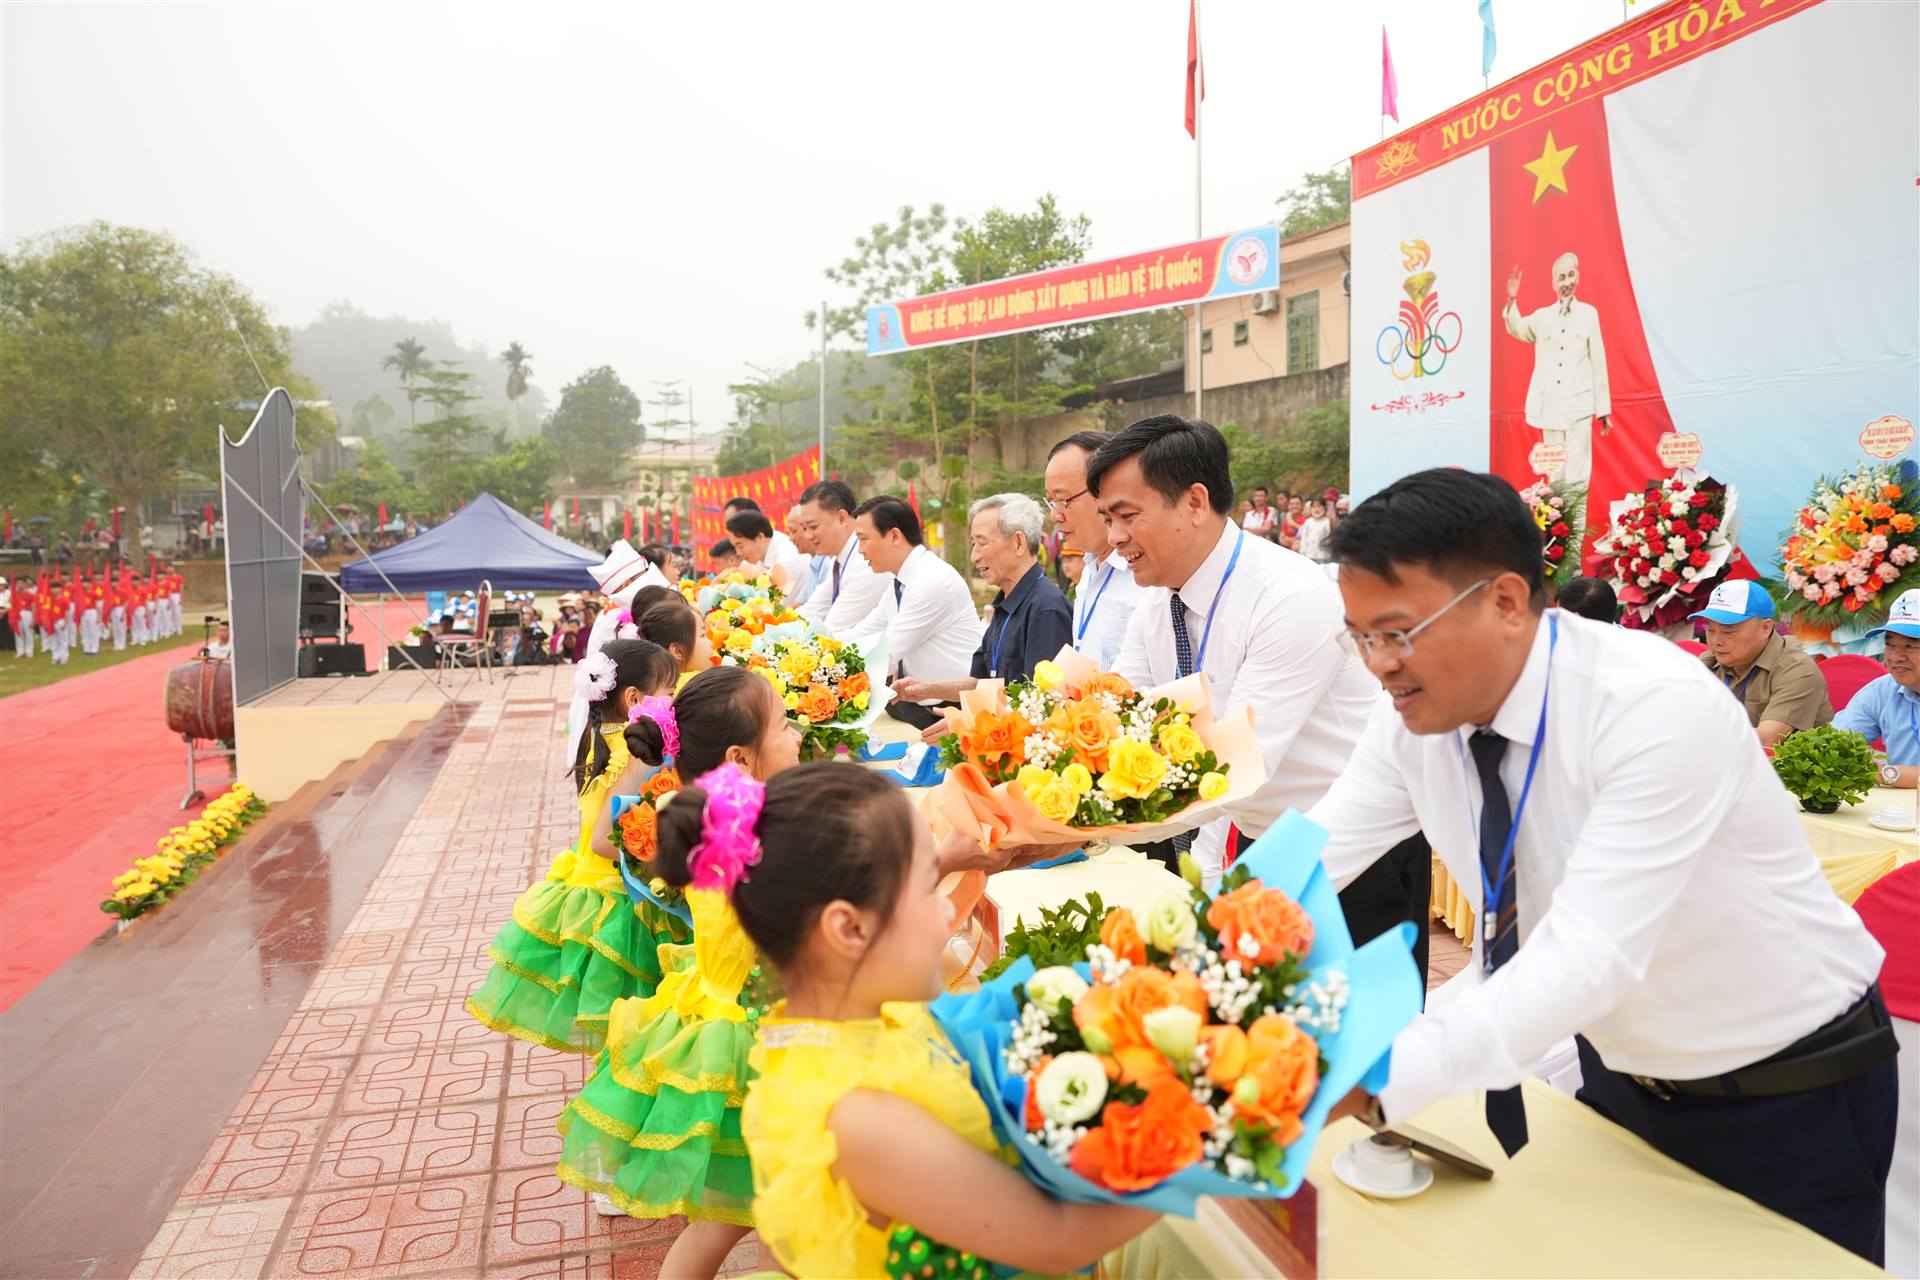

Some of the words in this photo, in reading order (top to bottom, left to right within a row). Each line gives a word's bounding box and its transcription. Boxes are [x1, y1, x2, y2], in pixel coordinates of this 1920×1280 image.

[1440, 92, 1522, 150] NƯỚC
[1532, 42, 1634, 107] CỘNG
[988, 295, 1006, 320] LAO
[1036, 282, 1057, 312] XÂY
[1089, 271, 1105, 302] VÀ
[1106, 265, 1130, 299] BẢO
[1131, 263, 1146, 298] VỆ
[1147, 255, 1164, 291] TỔ
[1165, 250, 1203, 291] QUỐC!
